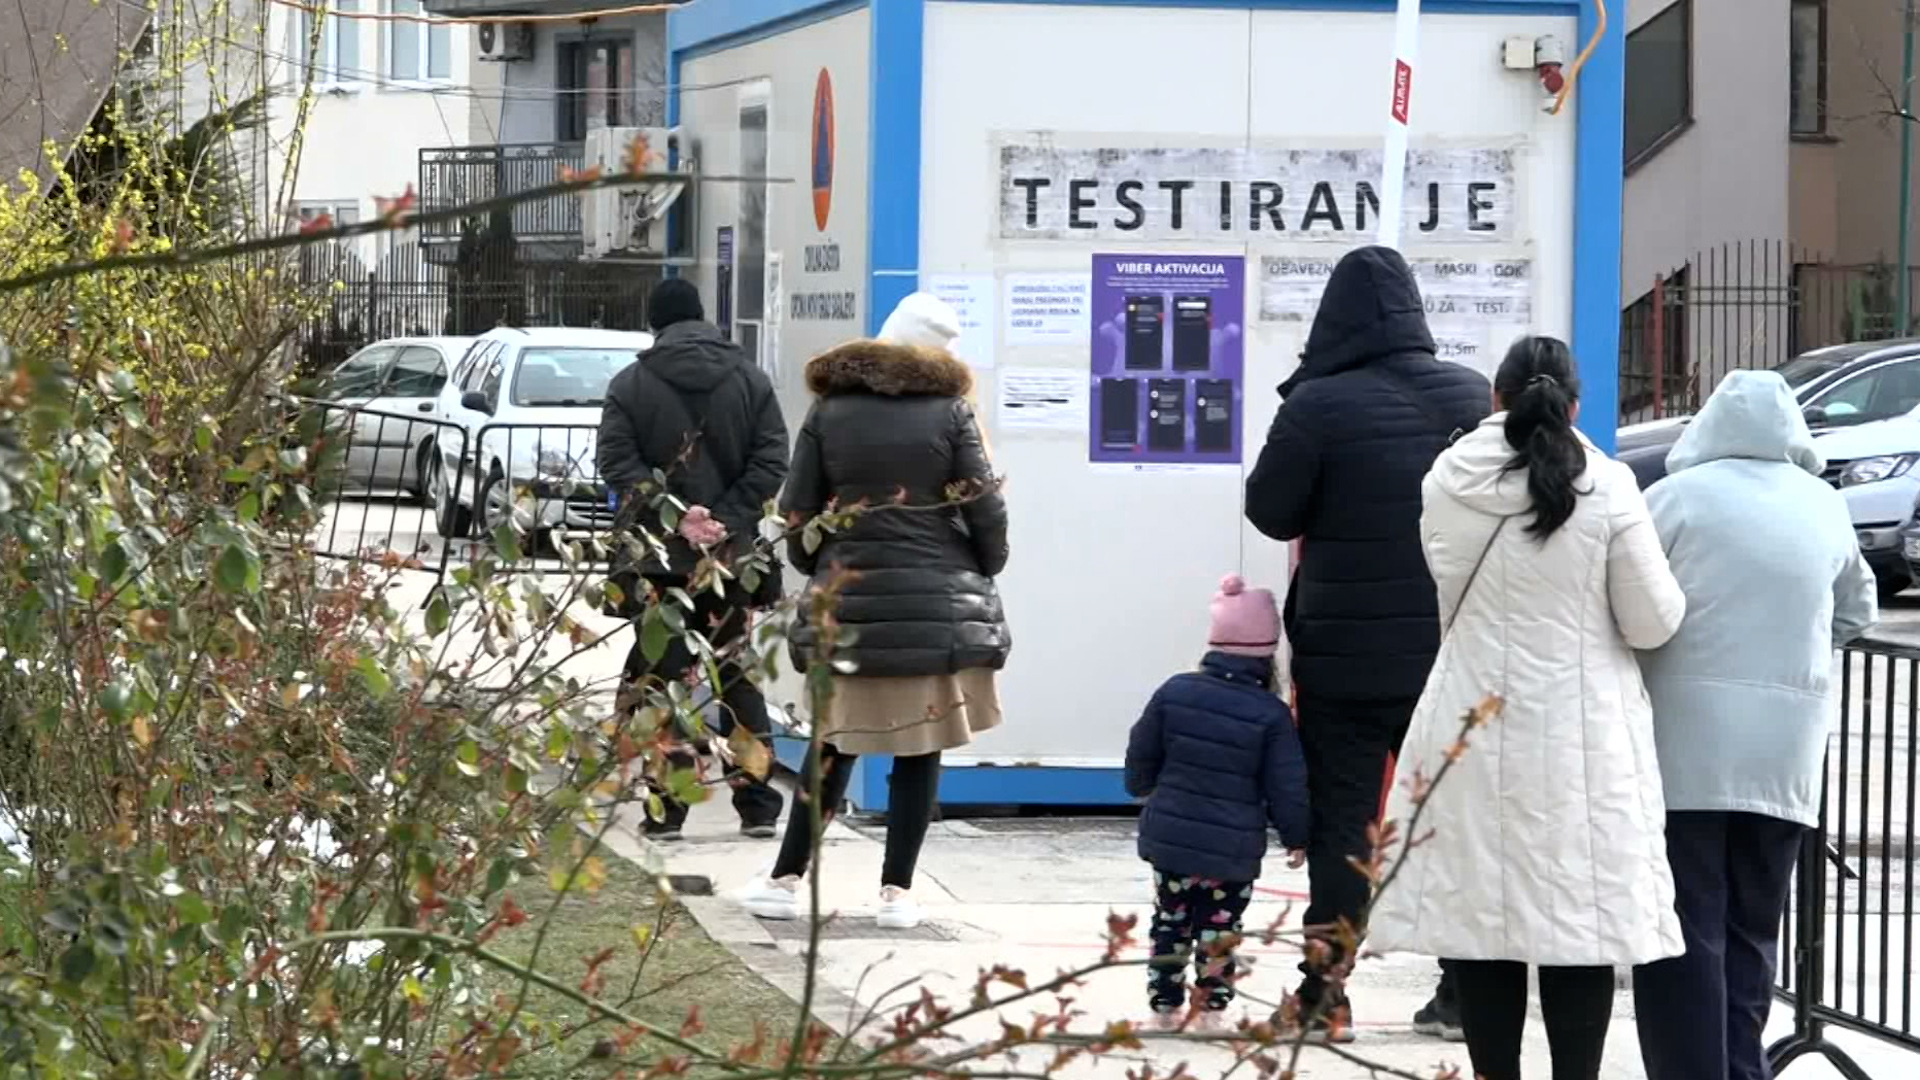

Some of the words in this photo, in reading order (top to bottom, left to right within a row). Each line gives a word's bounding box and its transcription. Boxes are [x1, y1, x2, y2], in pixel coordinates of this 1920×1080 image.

[1116, 262, 1152, 274] VIBER
[1154, 263, 1225, 275] AKTIVACIJA
[1269, 262, 1335, 276] OBAVEZN
[1434, 263, 1477, 277] MASKI
[1438, 300, 1455, 313] ZA
